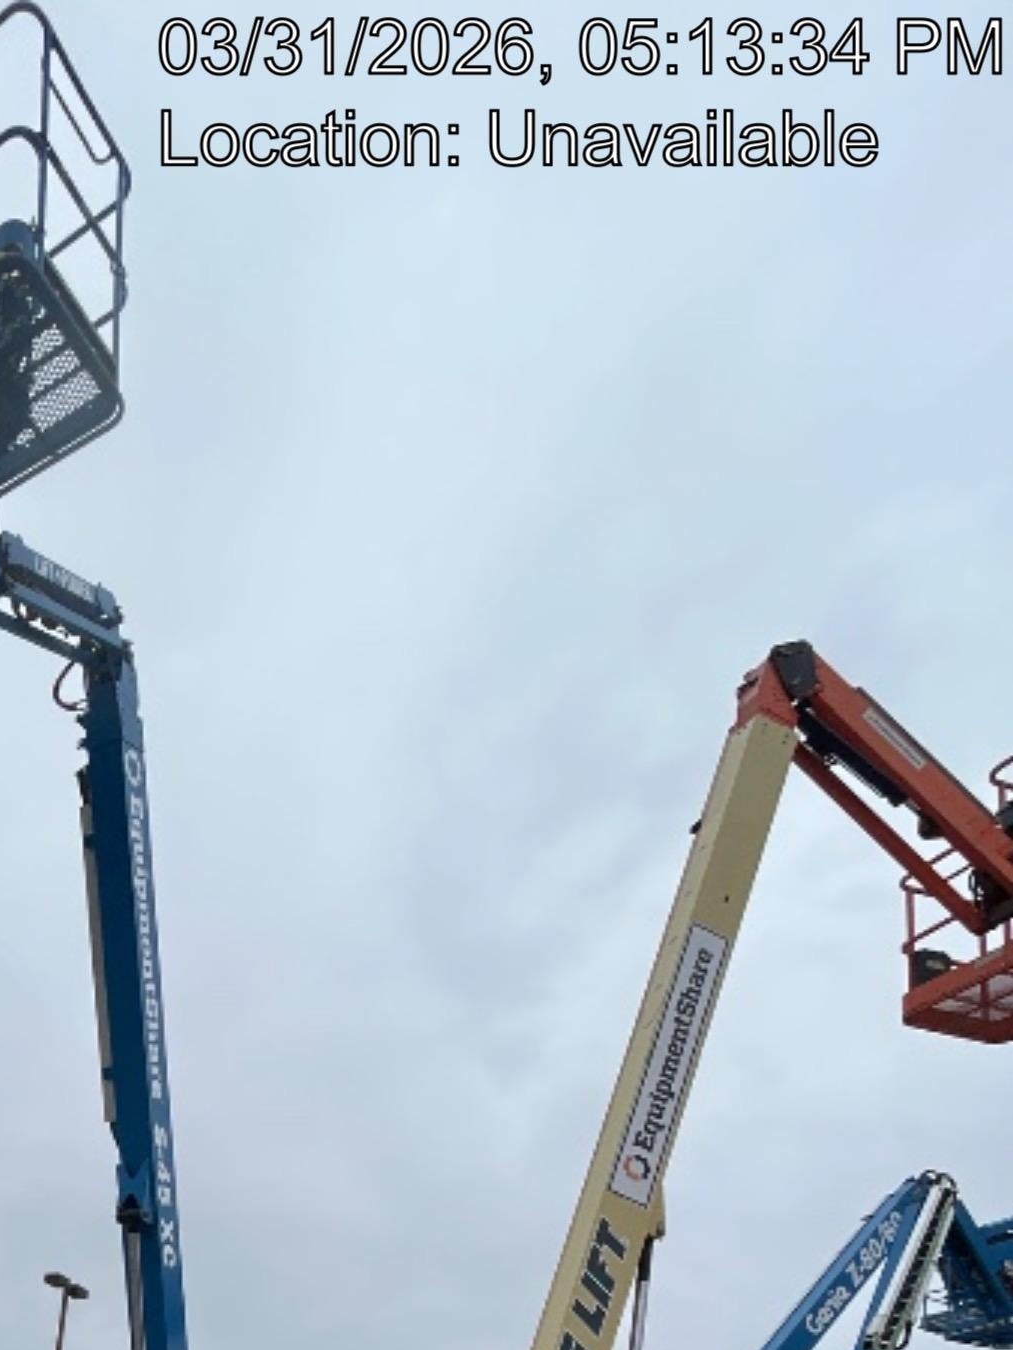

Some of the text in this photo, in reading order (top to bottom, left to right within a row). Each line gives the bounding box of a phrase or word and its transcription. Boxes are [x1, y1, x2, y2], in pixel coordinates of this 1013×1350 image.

[633, 947, 714, 1152] EquipmentShare
[158, 1218, 178, 1269] XC
[571, 1216, 628, 1337] LIFT
